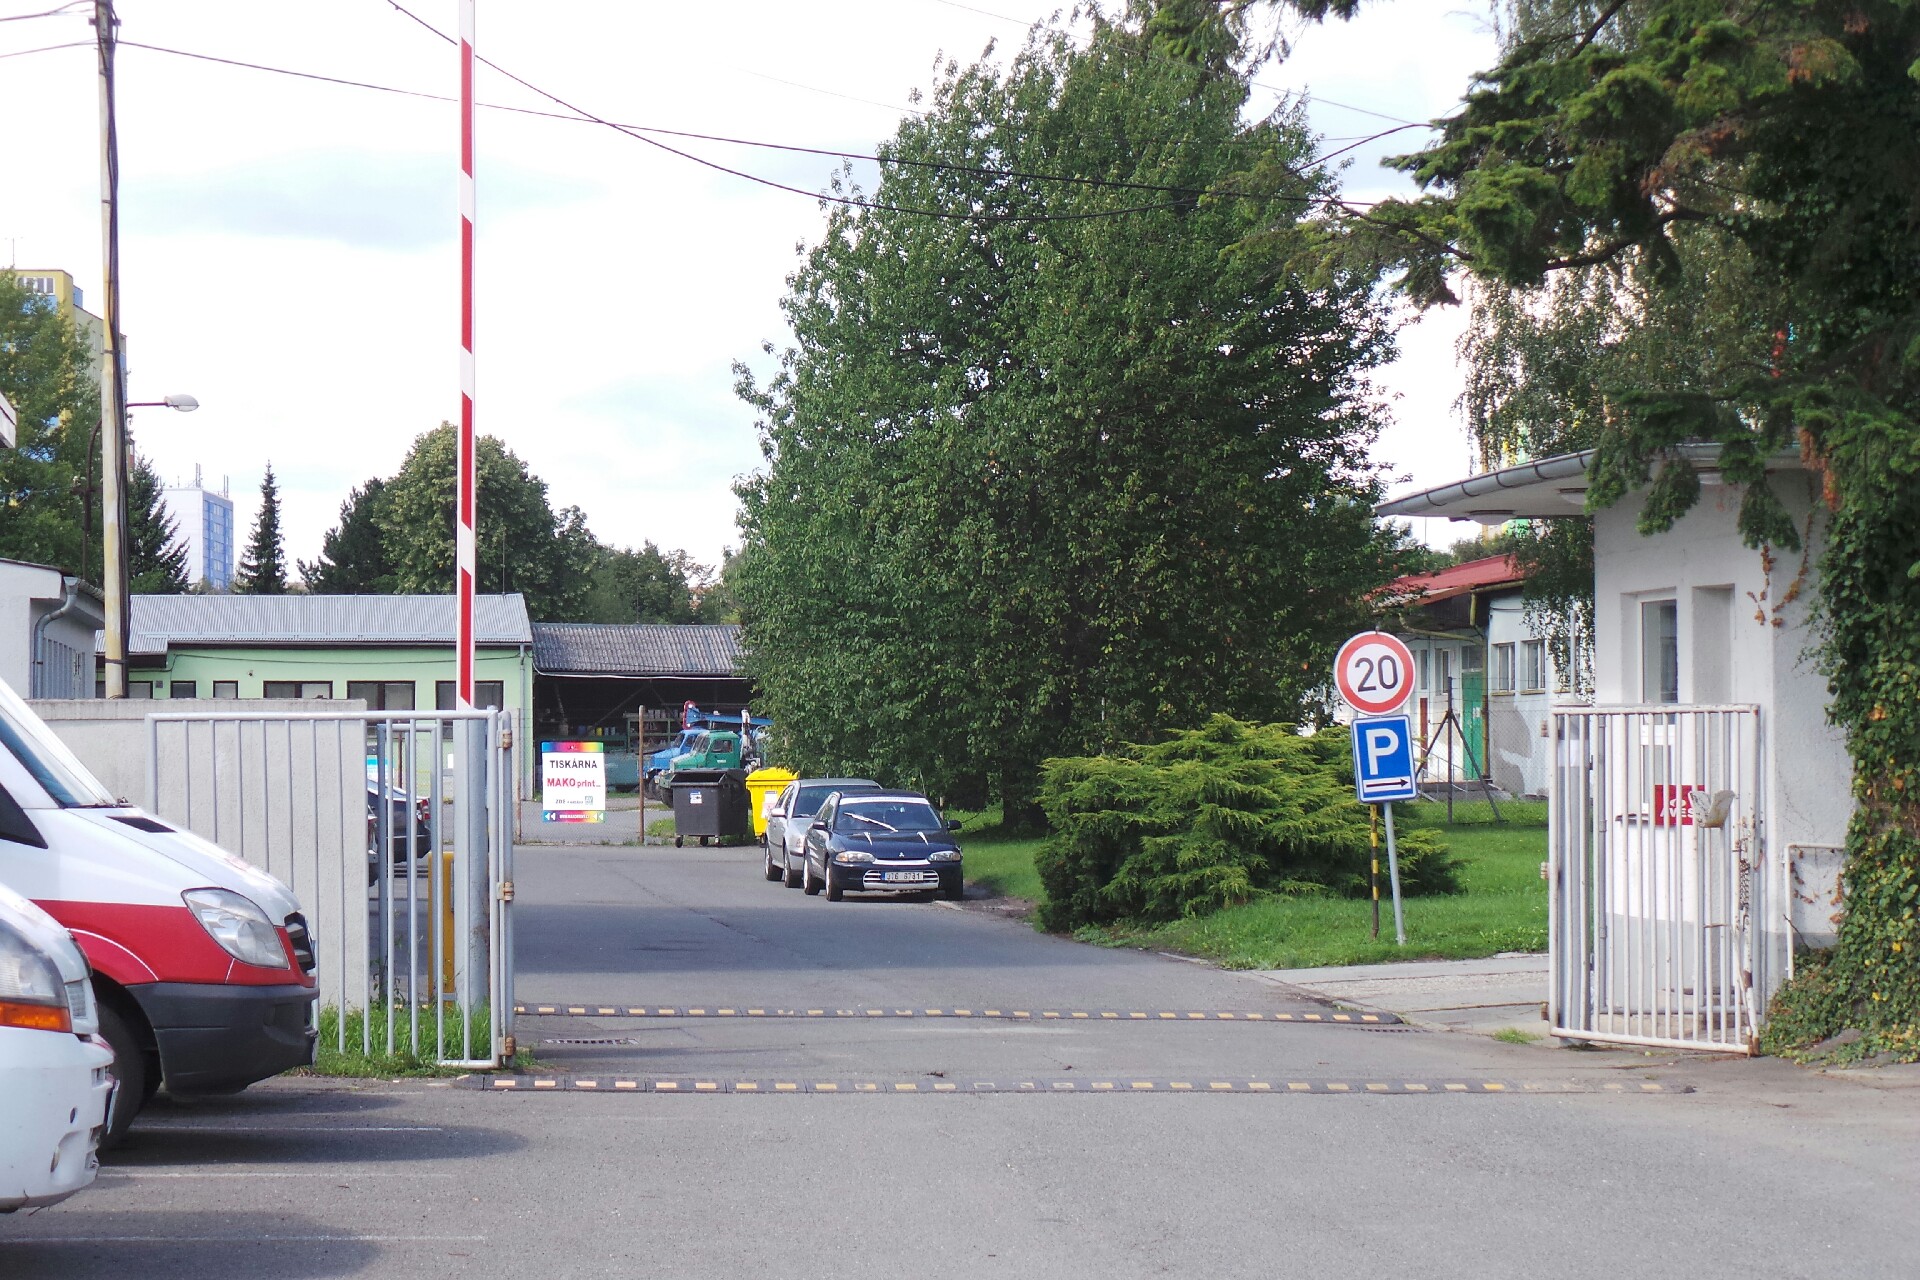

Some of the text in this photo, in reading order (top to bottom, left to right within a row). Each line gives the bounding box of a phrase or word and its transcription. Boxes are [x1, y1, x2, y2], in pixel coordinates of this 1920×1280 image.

[1355, 655, 1398, 692] 20
[550, 758, 598, 769] TISKÁRNA
[1366, 728, 1399, 776] P
[547, 778, 595, 788] MAKO print
